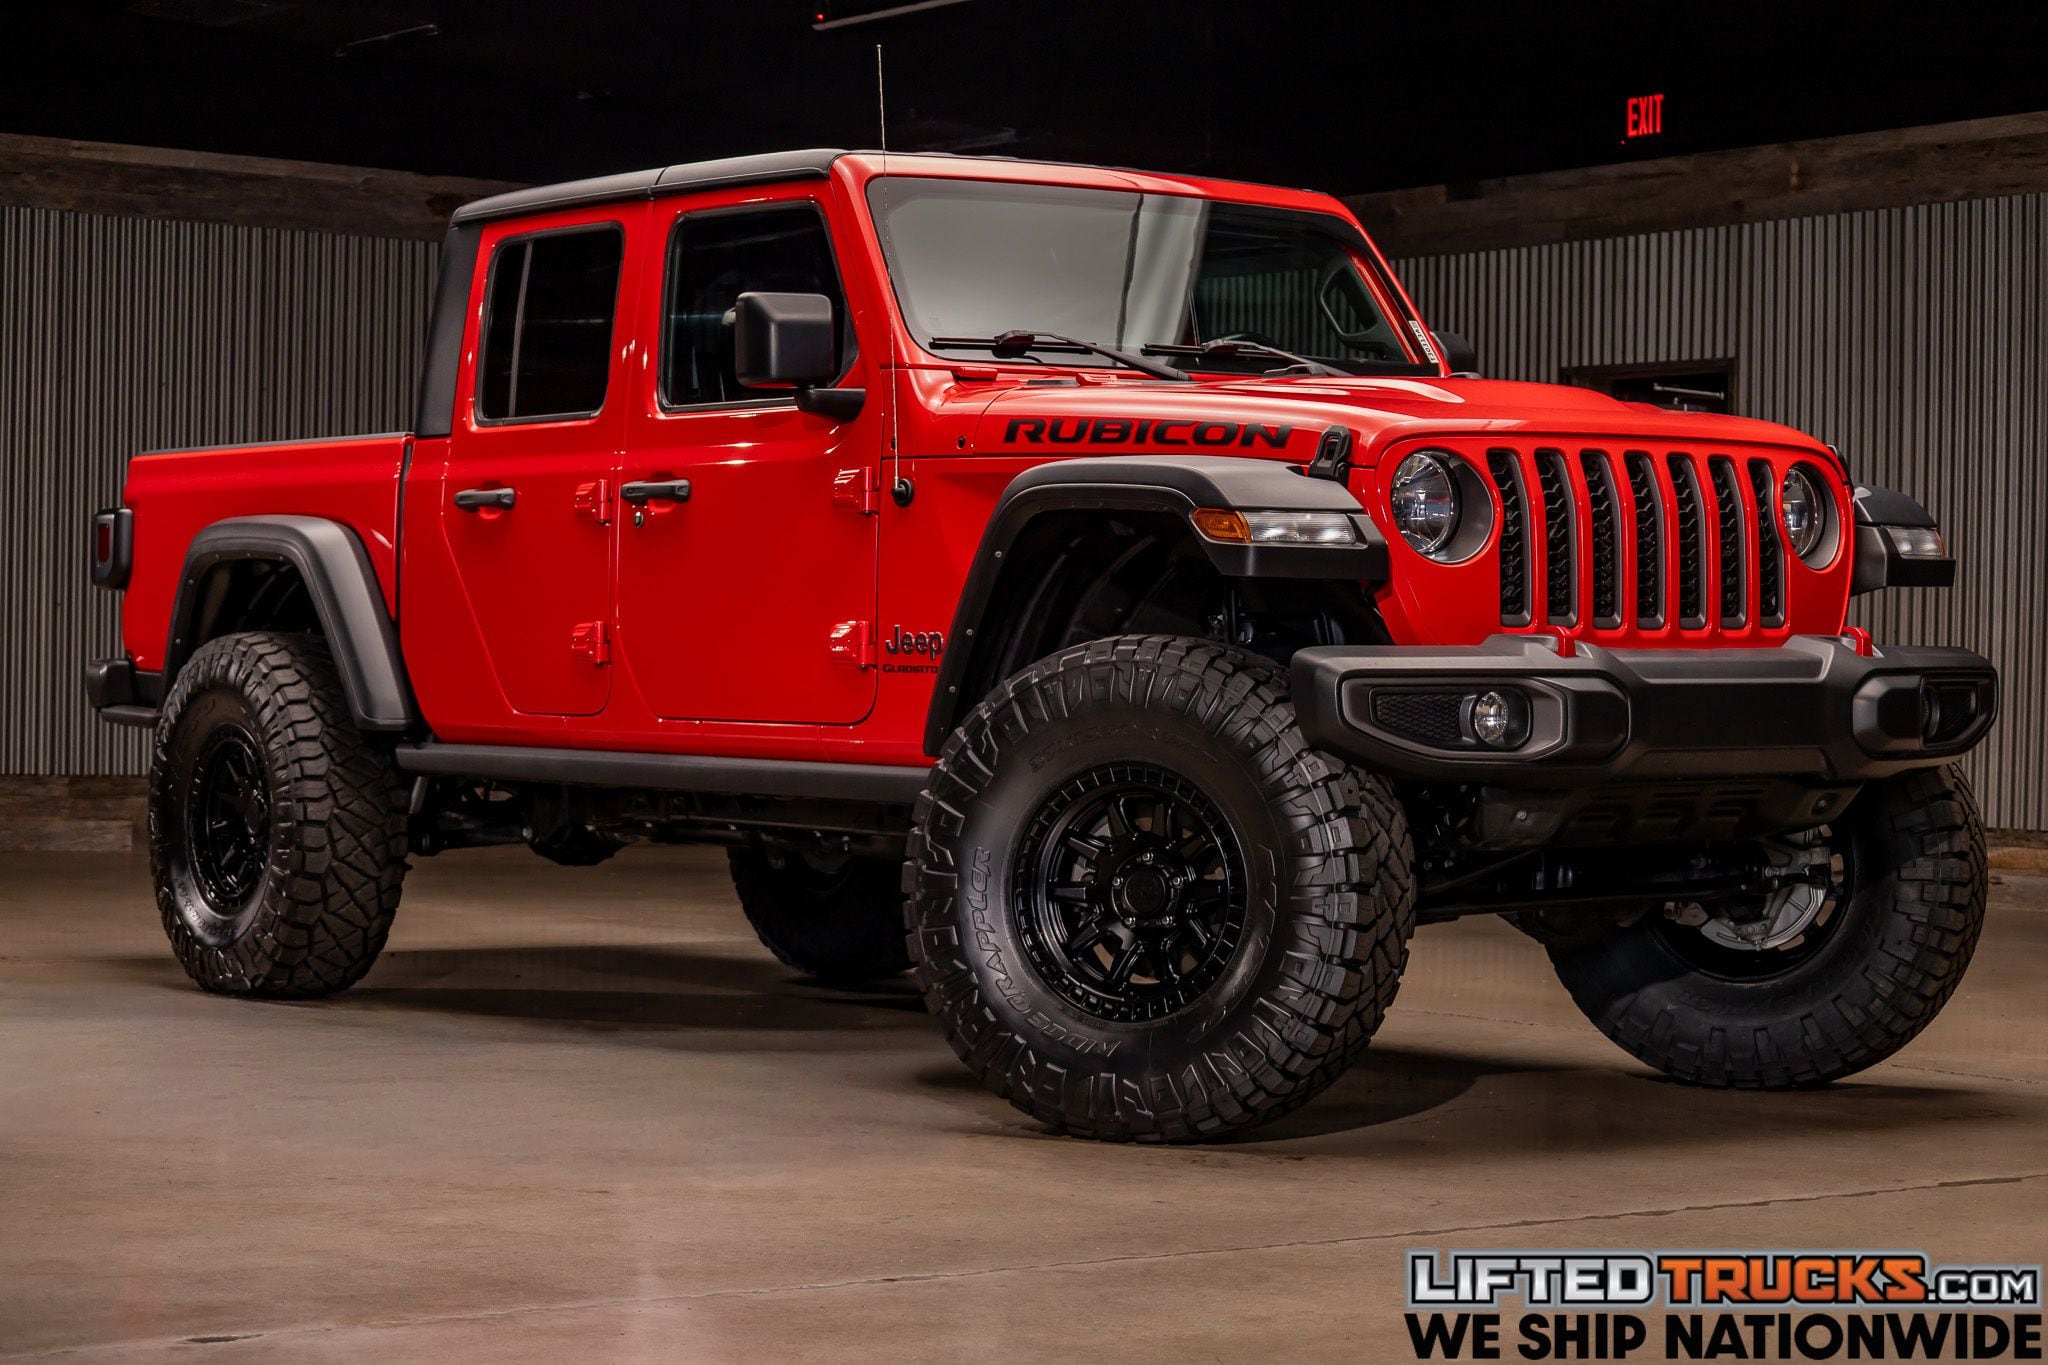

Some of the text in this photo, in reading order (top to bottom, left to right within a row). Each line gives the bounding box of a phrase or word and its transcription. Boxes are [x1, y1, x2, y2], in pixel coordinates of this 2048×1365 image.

[1627, 94, 1664, 137] EXIT
[1003, 418, 1293, 449] RUBICON
[885, 624, 943, 660] Jeep
[882, 664, 940, 674] GLADIATO
[967, 846, 1032, 1014] GRAPPLER
